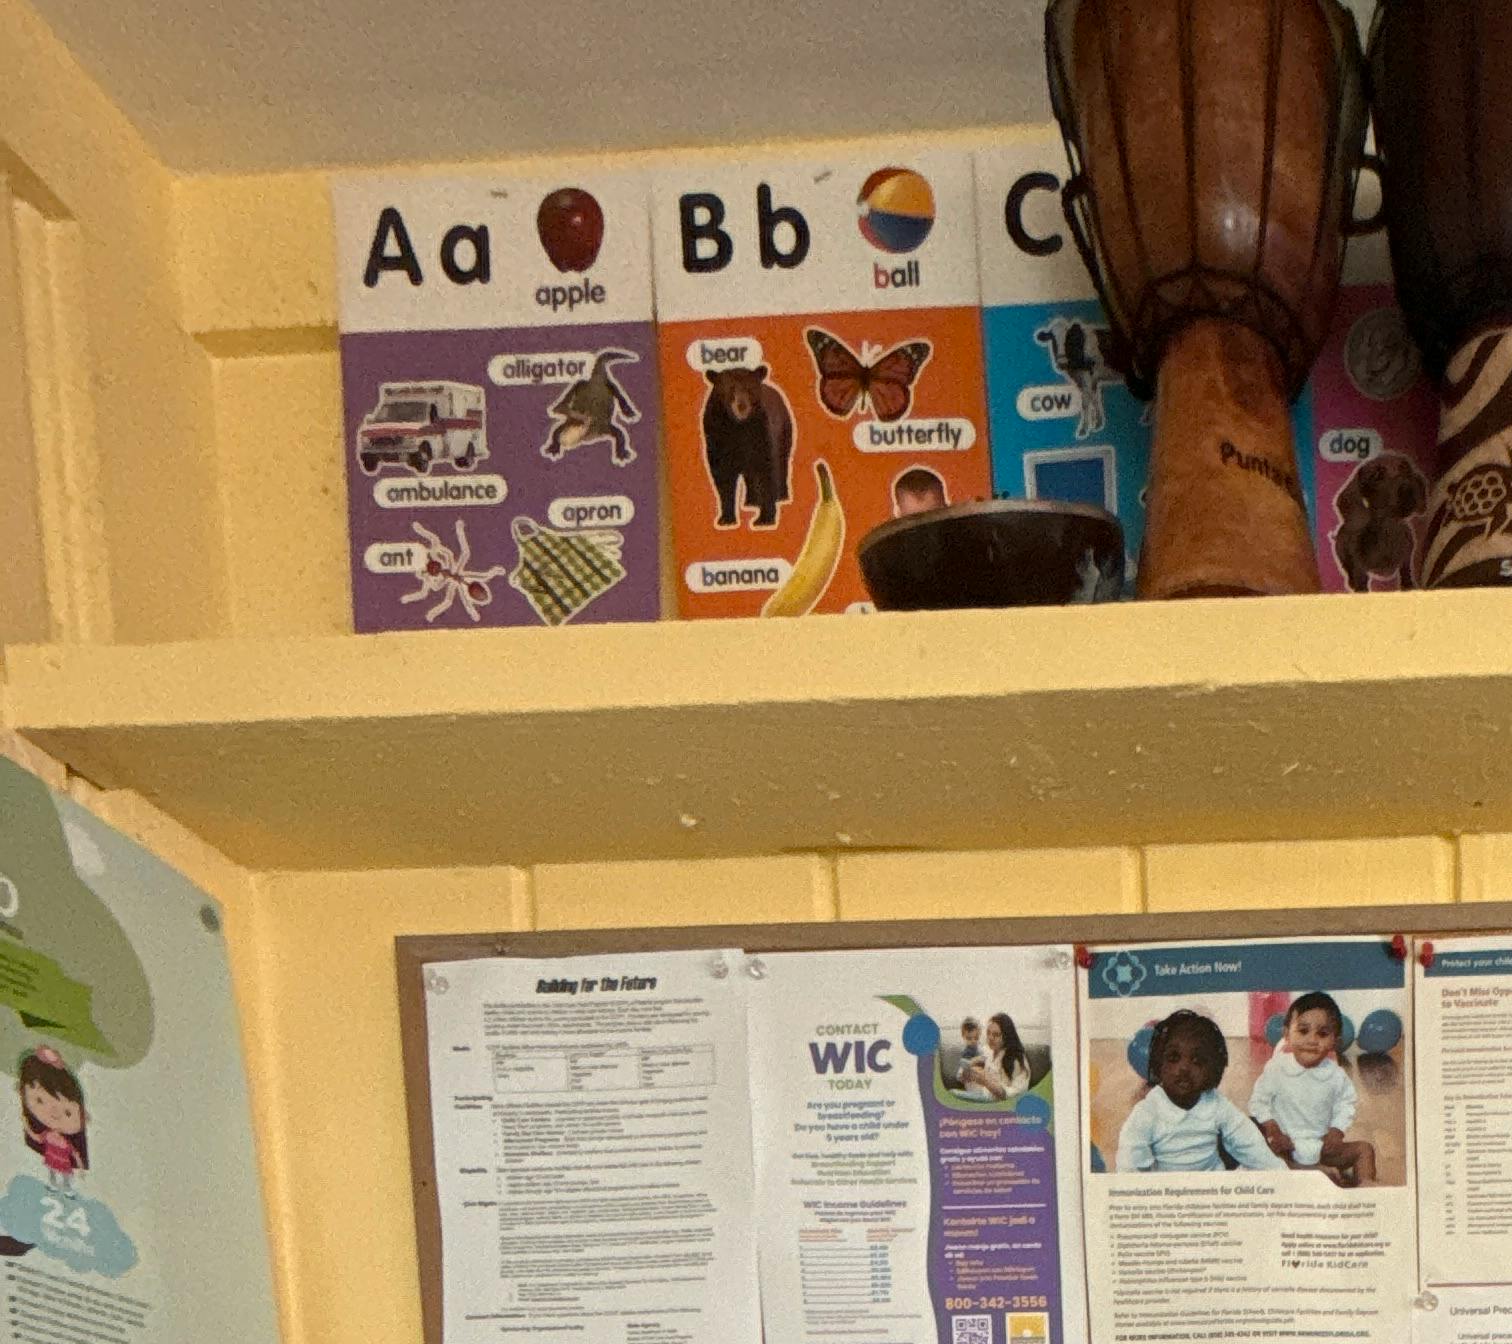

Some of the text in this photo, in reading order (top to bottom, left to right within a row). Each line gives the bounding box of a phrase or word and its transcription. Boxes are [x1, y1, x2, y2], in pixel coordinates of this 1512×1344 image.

[680, 183, 811, 273] Bb
[363, 206, 491, 287] Aa
[874, 260, 920, 290] ball
[535, 278, 607, 310] apple
[701, 342, 749, 364] bear
[502, 355, 587, 383] alligator
[1030, 392, 1071, 411] cow
[869, 422, 963, 450] butterfly
[1330, 432, 1370, 459] dog
[386, 480, 497, 502] ambulance
[563, 501, 622, 526] apron
[379, 545, 415, 567] ant
[701, 563, 780, 586] banana
[1155, 965, 1176, 976] Take
[1179, 963, 1212, 974] Action
[816, 1024, 878, 1036] CONTACT
[809, 1039, 892, 1074] WIC
[828, 1079, 872, 1091] TODAY
[945, 1296, 1047, 1309] 800-342-3556
